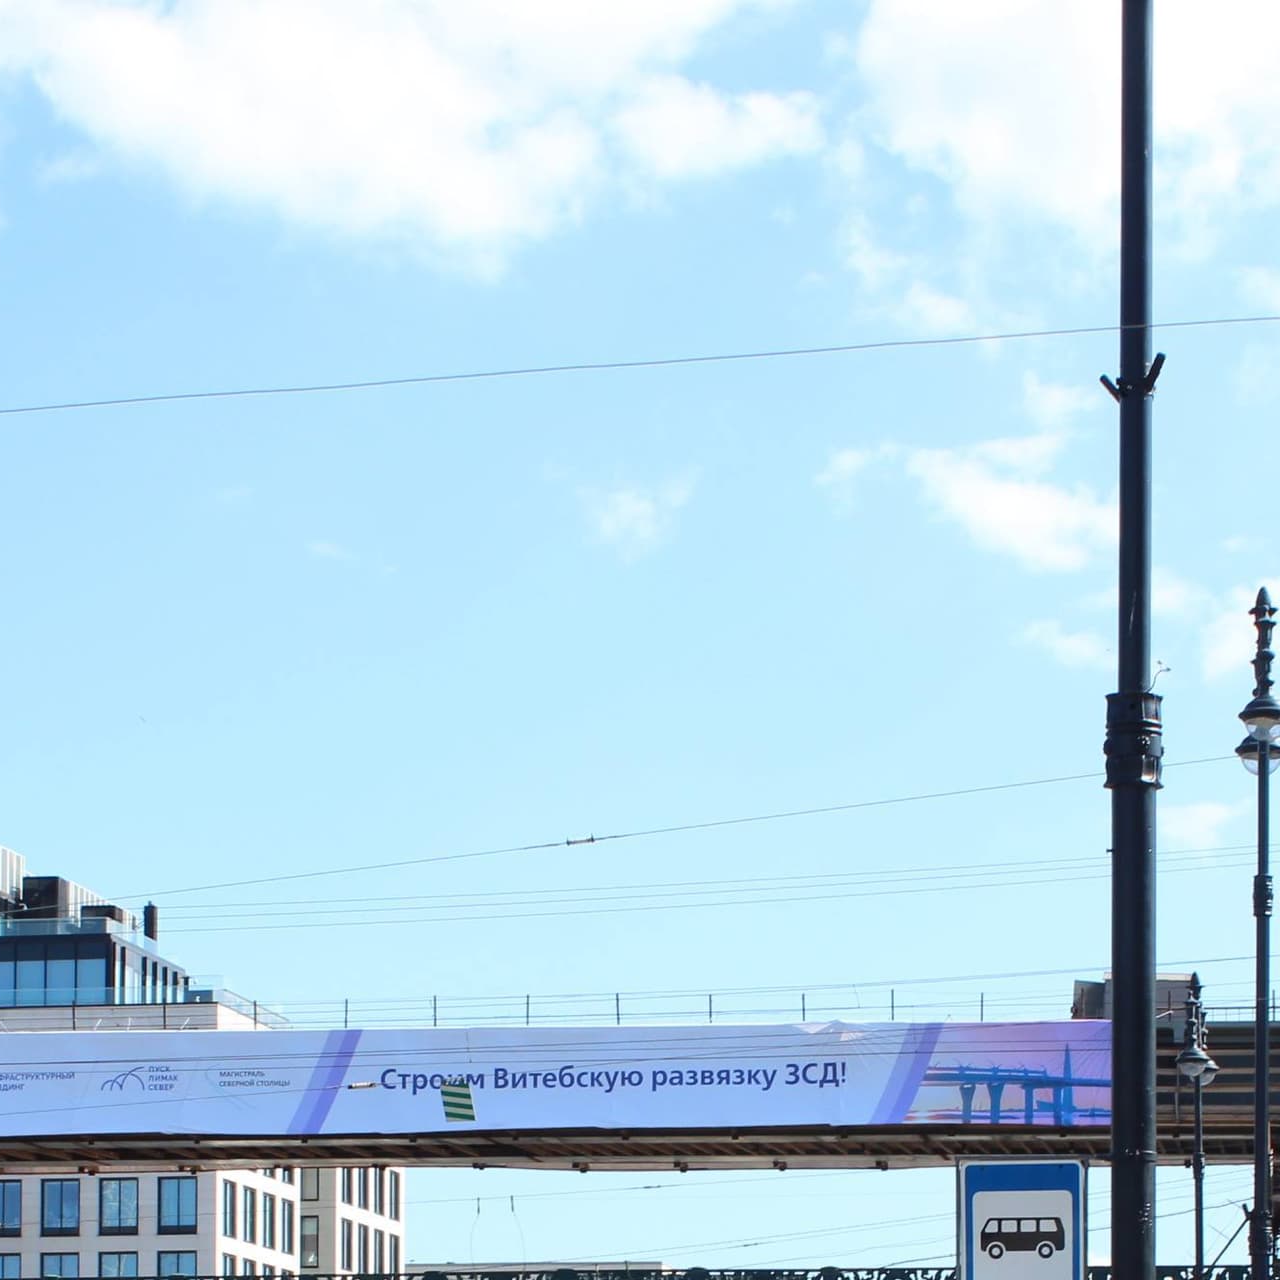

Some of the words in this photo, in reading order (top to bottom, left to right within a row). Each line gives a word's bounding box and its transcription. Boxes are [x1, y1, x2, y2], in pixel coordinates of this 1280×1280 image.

[493, 1065, 644, 1092] Витебскую
[651, 1067, 777, 1091] развязку
[785, 1062, 847, 1088] ЗСД!
[148, 1083, 174, 1091] СЕВЕР
[219, 1080, 255, 1088] СЕВЕРНОЙ
[256, 1079, 291, 1087] СТОЛИЦЫ
